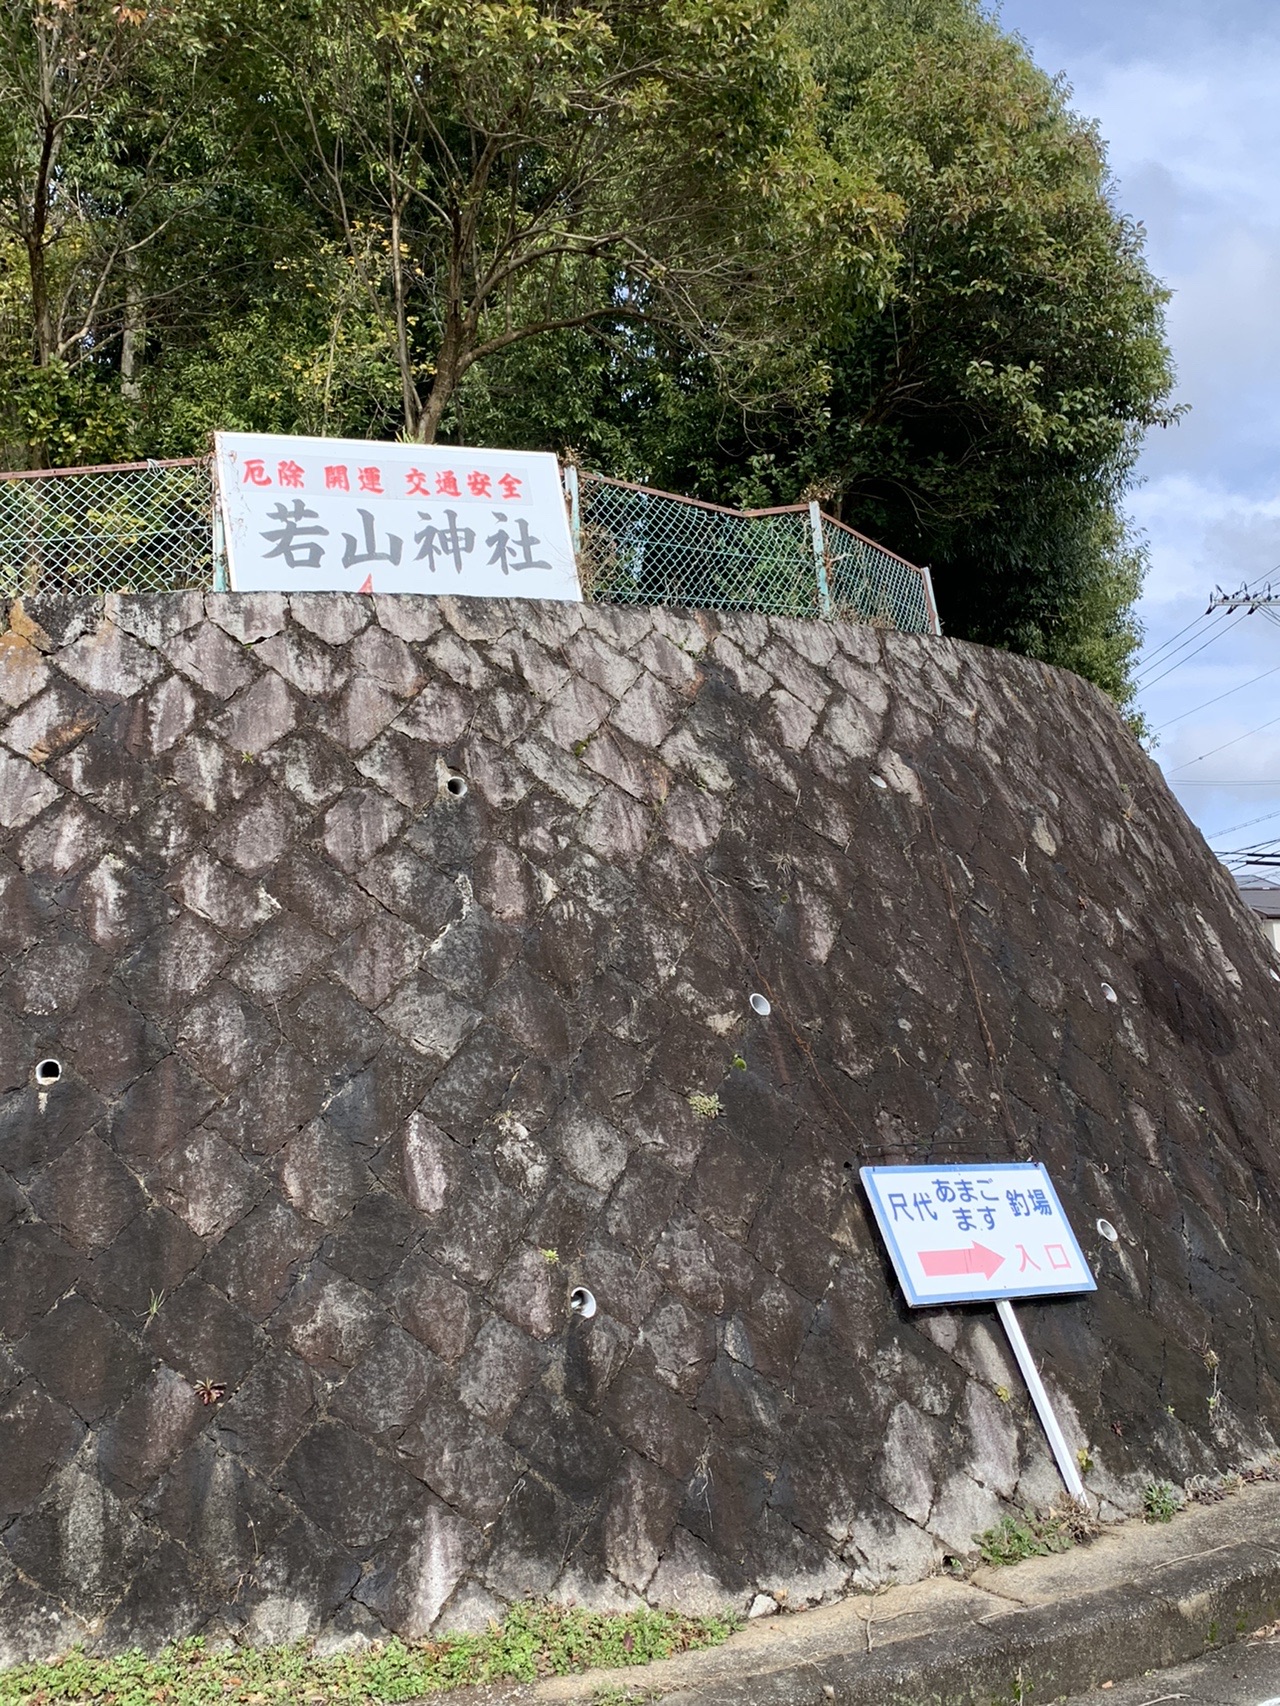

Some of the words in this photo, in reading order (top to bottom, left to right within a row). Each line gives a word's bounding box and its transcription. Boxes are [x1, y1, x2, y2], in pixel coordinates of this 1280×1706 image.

[243, 459, 305, 489] 厄除
[324, 465, 385, 495] 開運
[404, 467, 523, 499] 交通安全
[259, 499, 553, 575] 若山神社
[931, 1178, 999, 1203] あまご
[1005, 1189, 1053, 1217] 釣場
[888, 1192, 938, 1222] 尺代
[952, 1206, 996, 1232] ます
[1014, 1244, 1072, 1273] 入口
